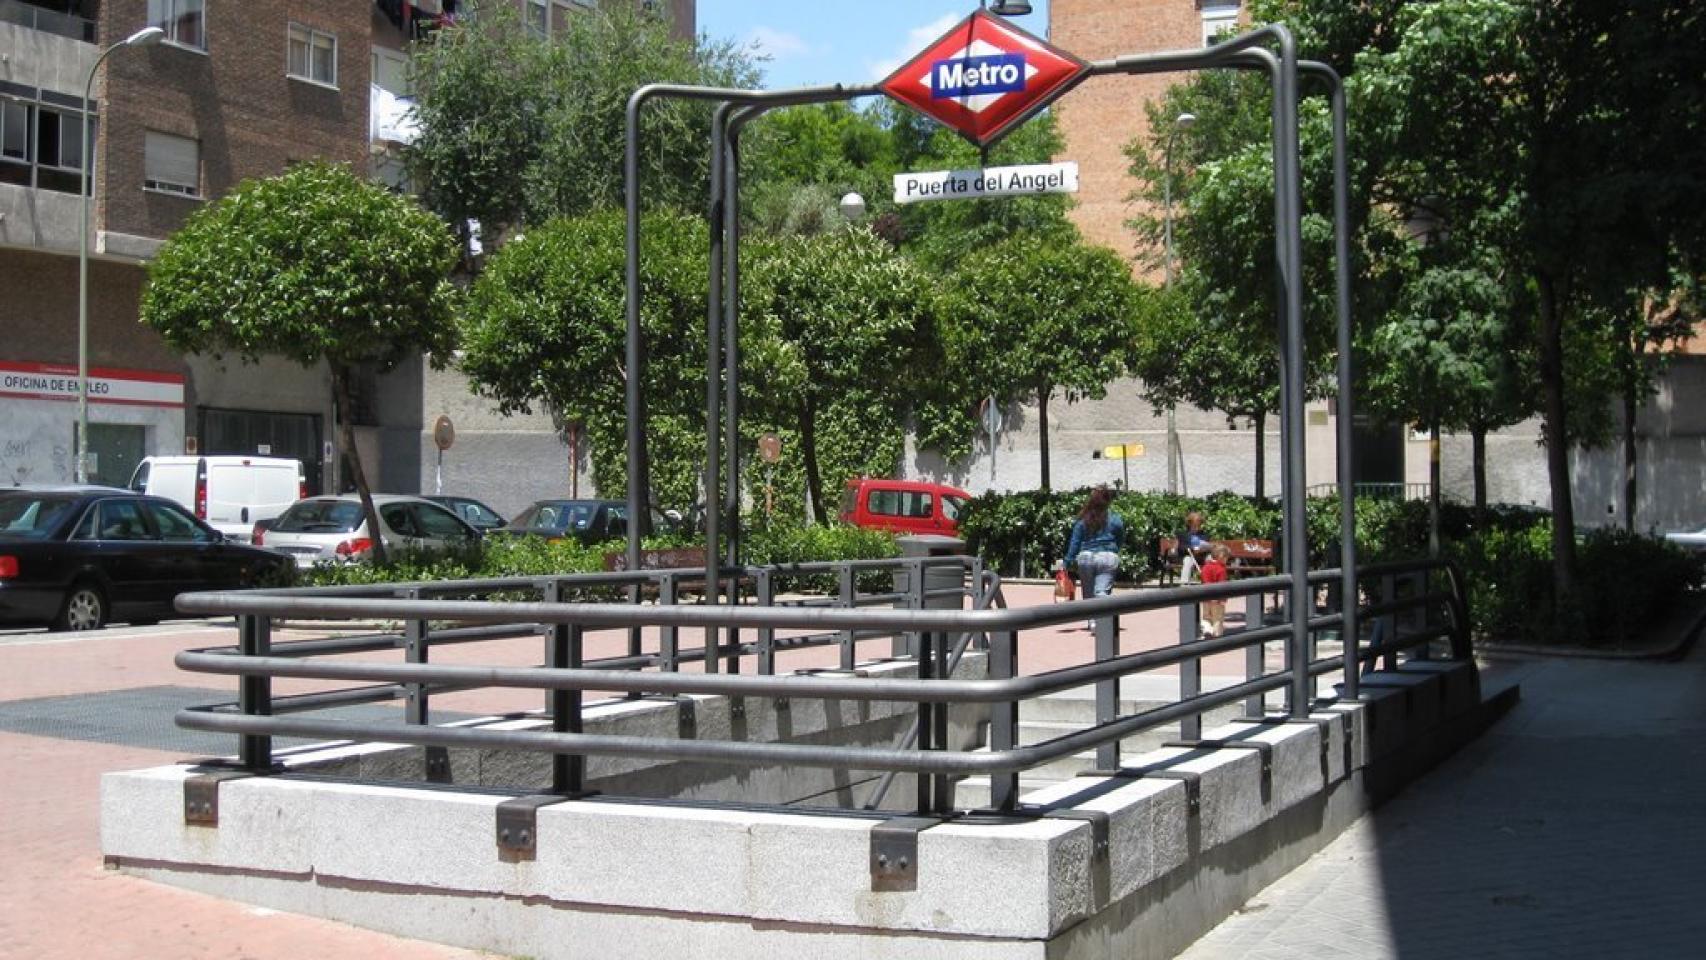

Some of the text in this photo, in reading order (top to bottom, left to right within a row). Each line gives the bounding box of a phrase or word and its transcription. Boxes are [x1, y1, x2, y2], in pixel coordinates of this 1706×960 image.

[939, 63, 1019, 90] Metro
[907, 169, 1064, 196] Puerta del Angel
[5, 376, 48, 389] OFICINA
[51, 379, 64, 391] DE
